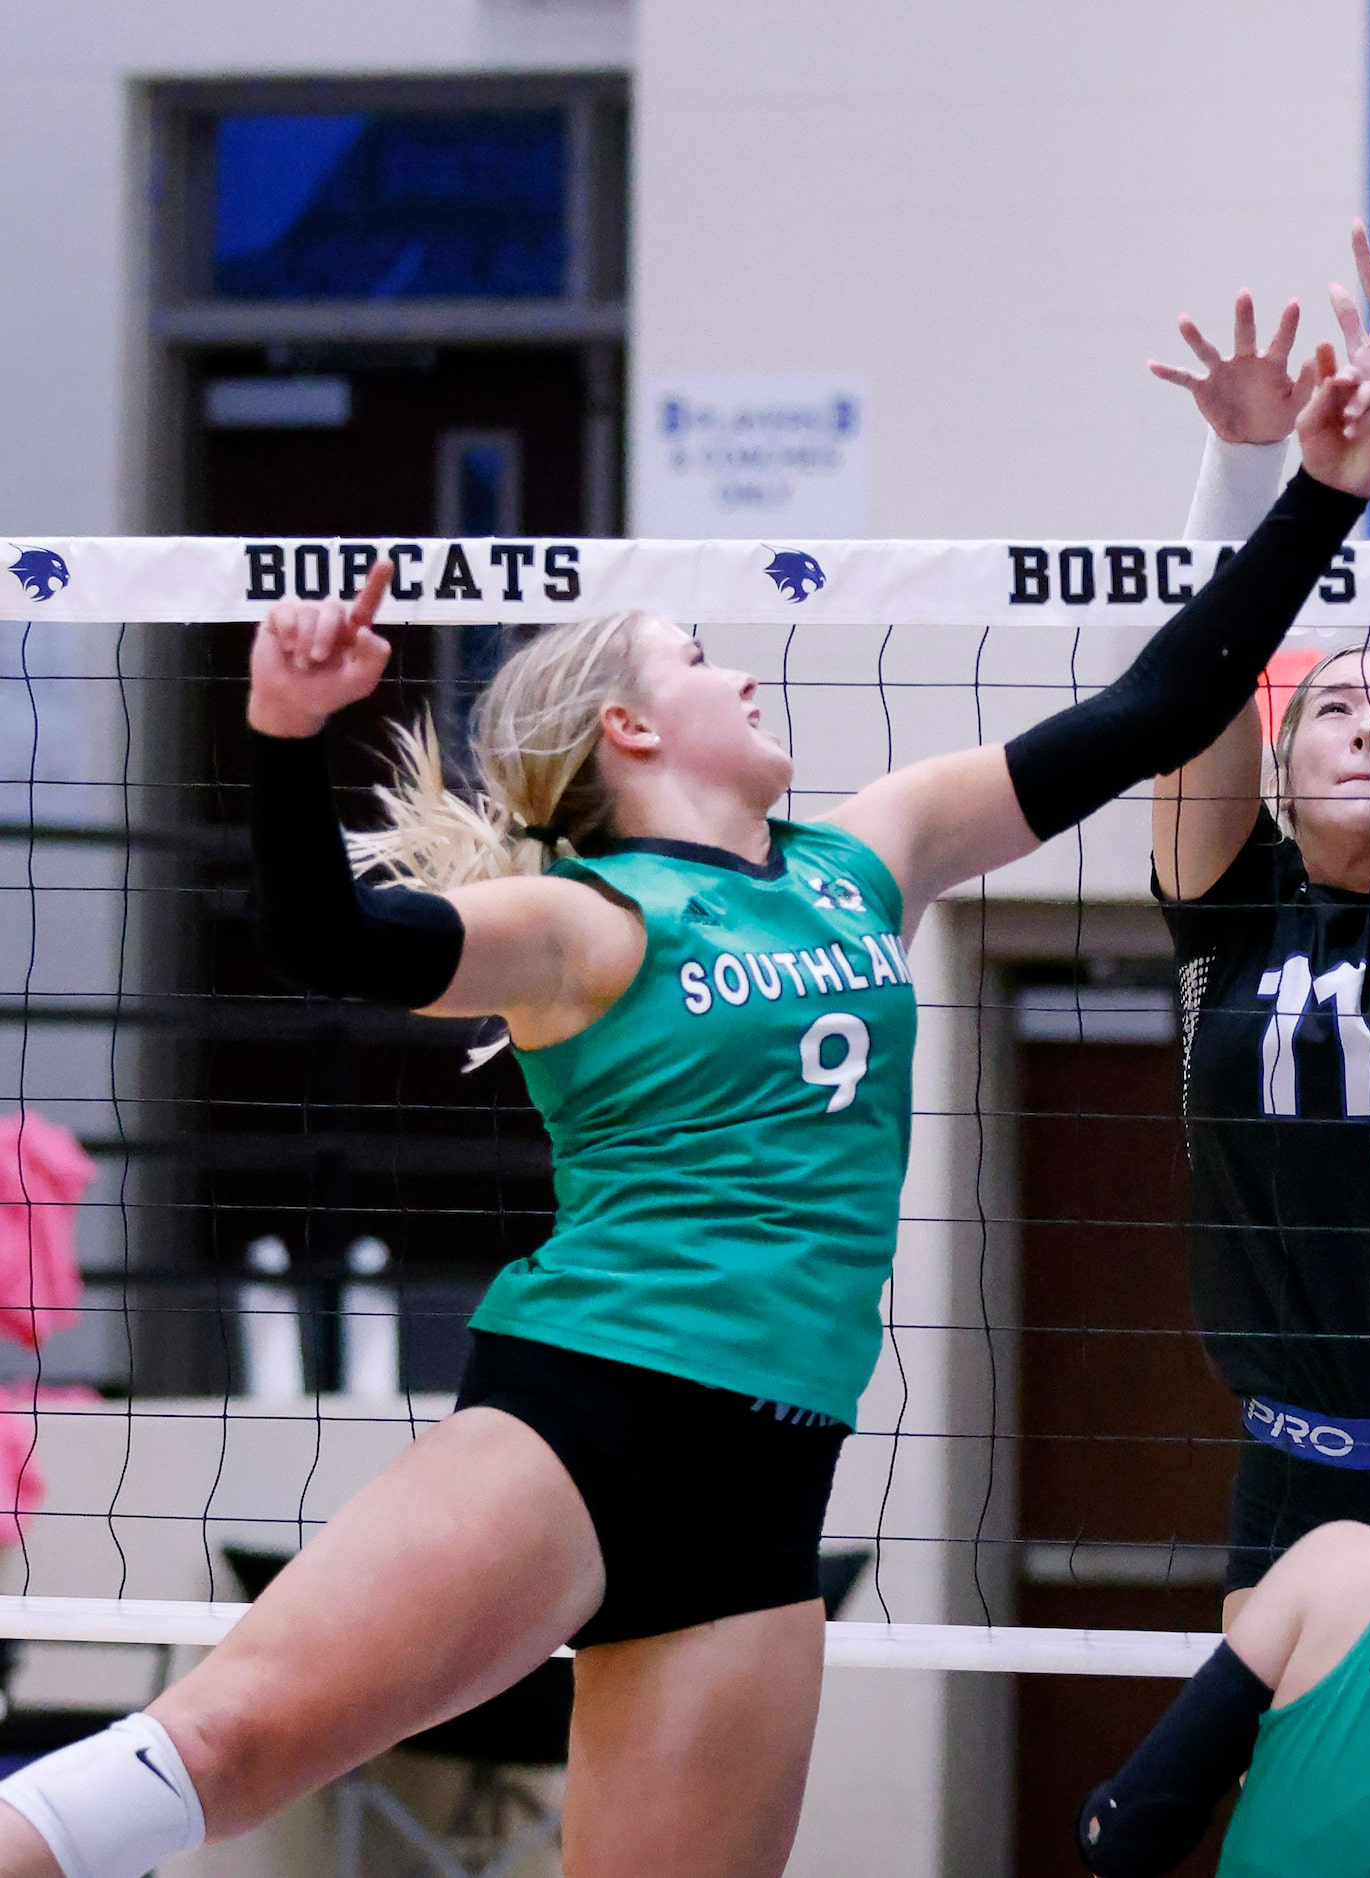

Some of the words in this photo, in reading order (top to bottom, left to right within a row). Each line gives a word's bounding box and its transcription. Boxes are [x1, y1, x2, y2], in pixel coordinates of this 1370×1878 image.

[244, 543, 581, 603] BOBCATS
[1008, 545, 1356, 605] BOBCS
[799, 1011, 871, 1114] 9
[1247, 1398, 1354, 1457] PRO
